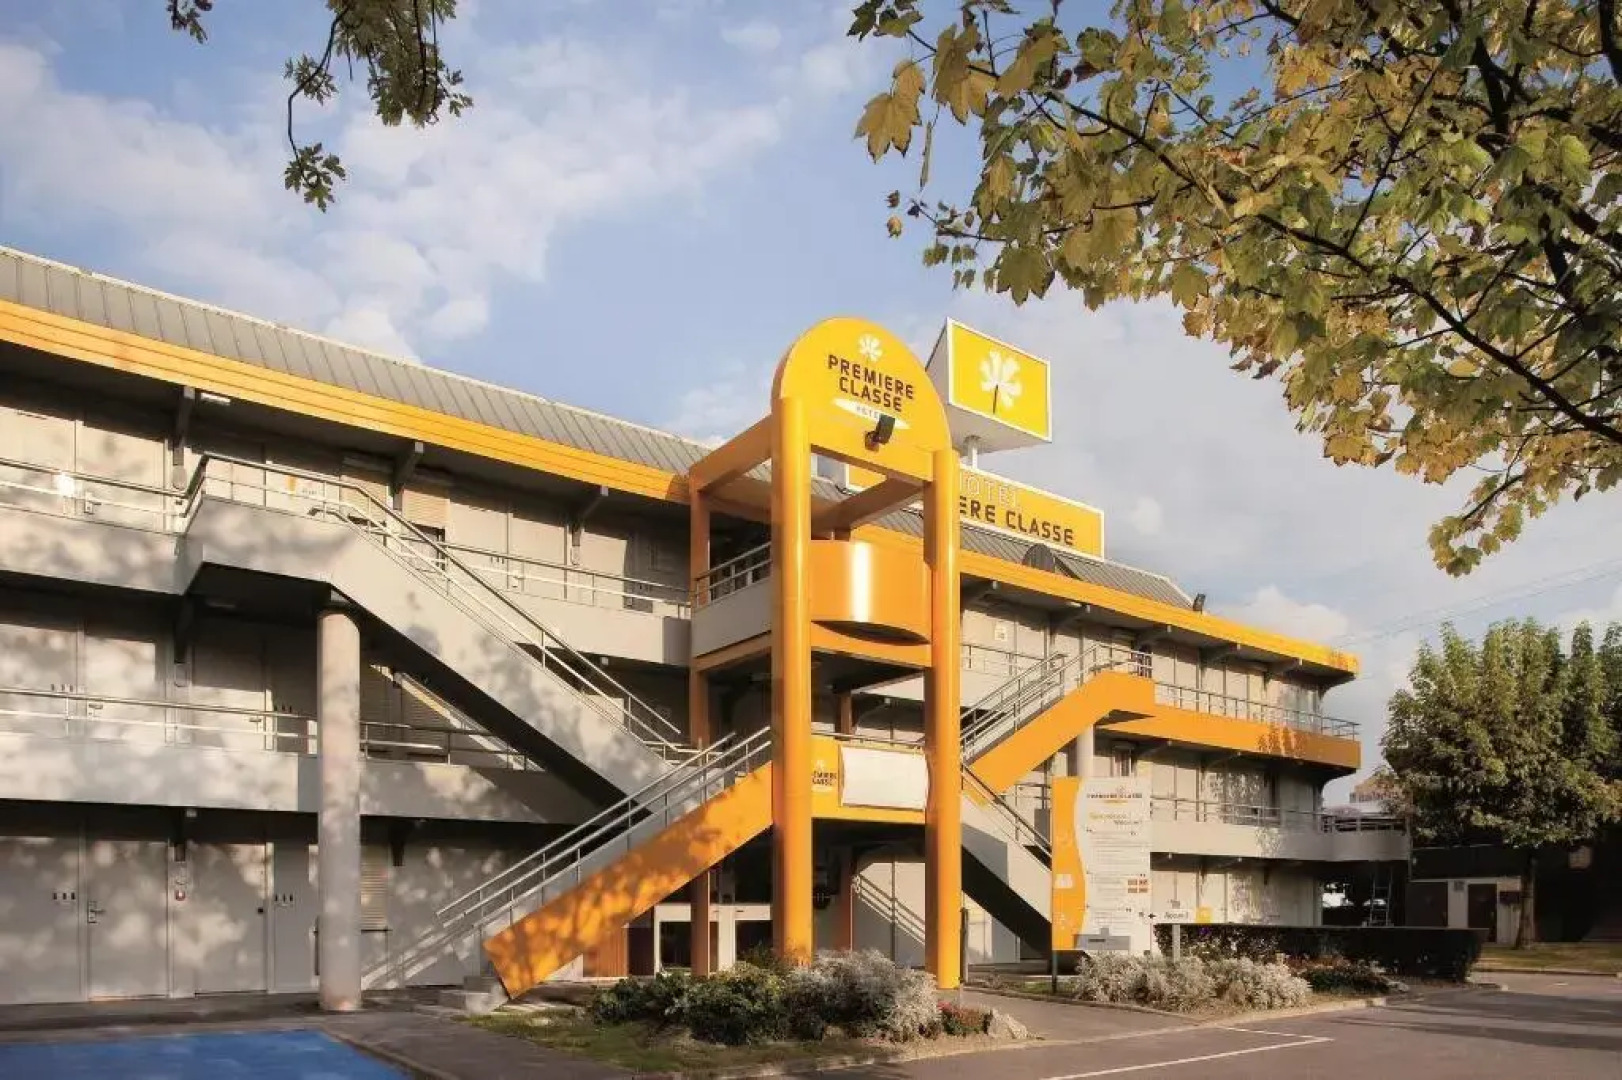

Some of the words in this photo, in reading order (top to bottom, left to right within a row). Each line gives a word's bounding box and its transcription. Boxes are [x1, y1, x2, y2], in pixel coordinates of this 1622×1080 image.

[828, 354, 914, 399] PREMIERE
[839, 376, 902, 412] CLASSE
[1005, 510, 1074, 546] CLASSE
